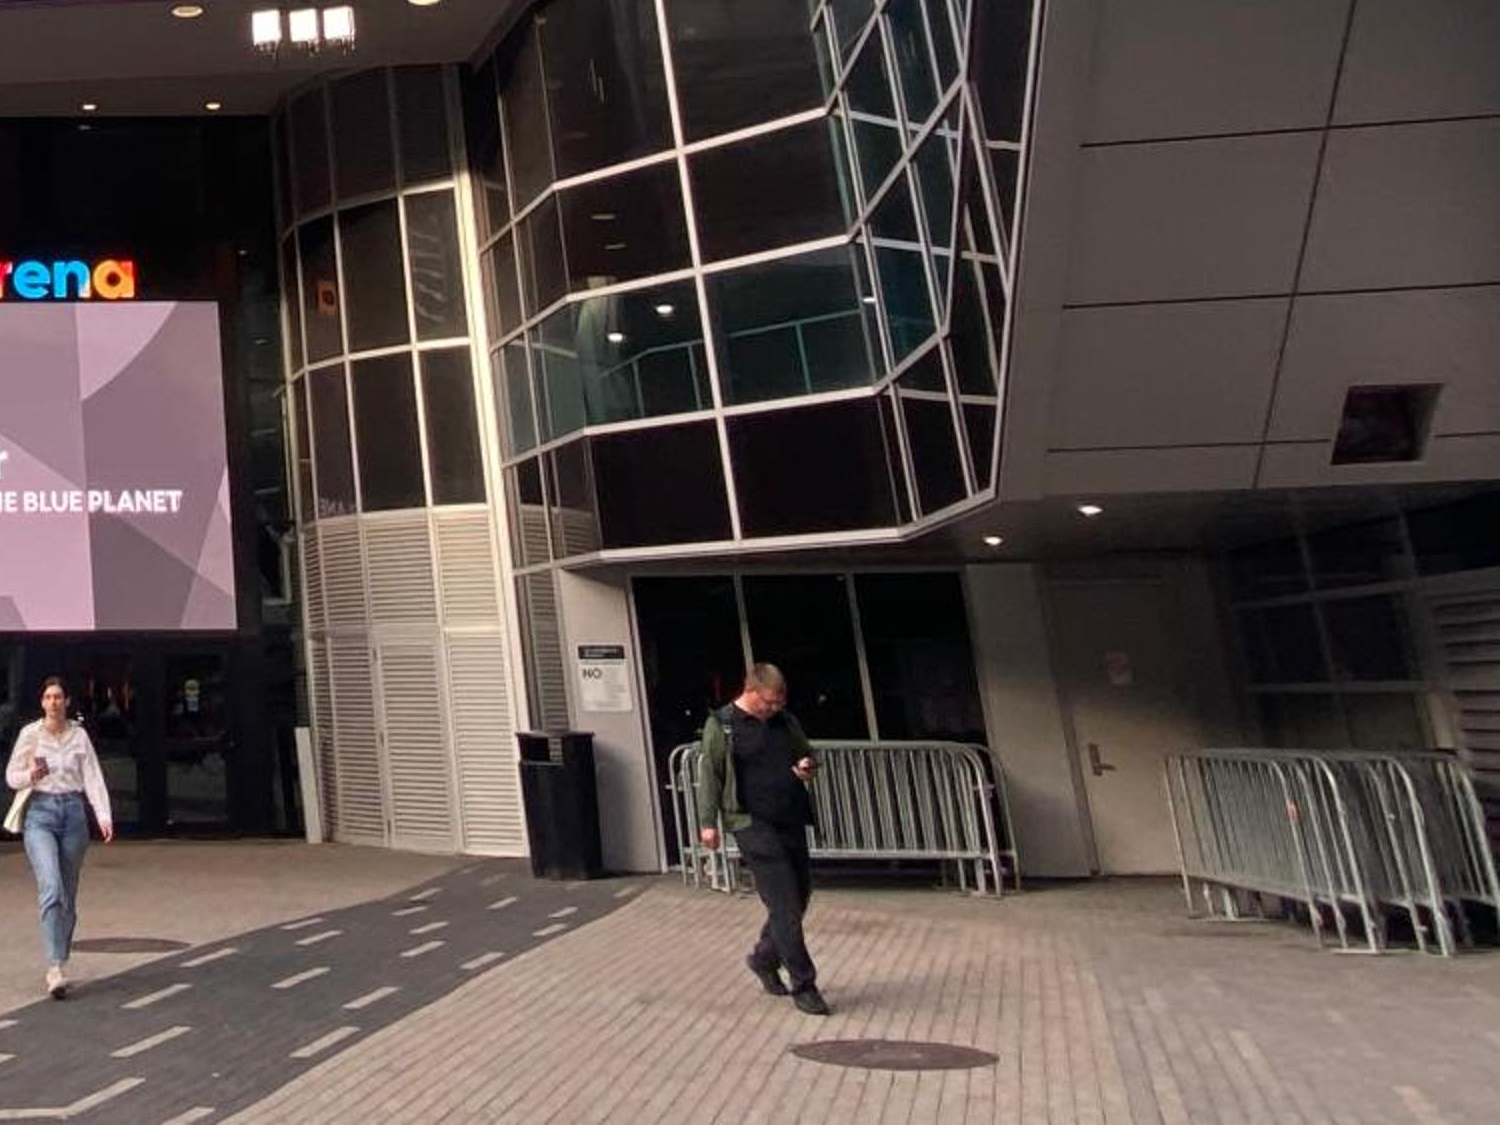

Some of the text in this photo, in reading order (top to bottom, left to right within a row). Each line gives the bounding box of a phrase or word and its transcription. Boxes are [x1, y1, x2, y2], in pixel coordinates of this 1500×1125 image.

[23, 490, 83, 513] BLUE
[87, 489, 183, 513] PLANET
[582, 667, 603, 680] NO
